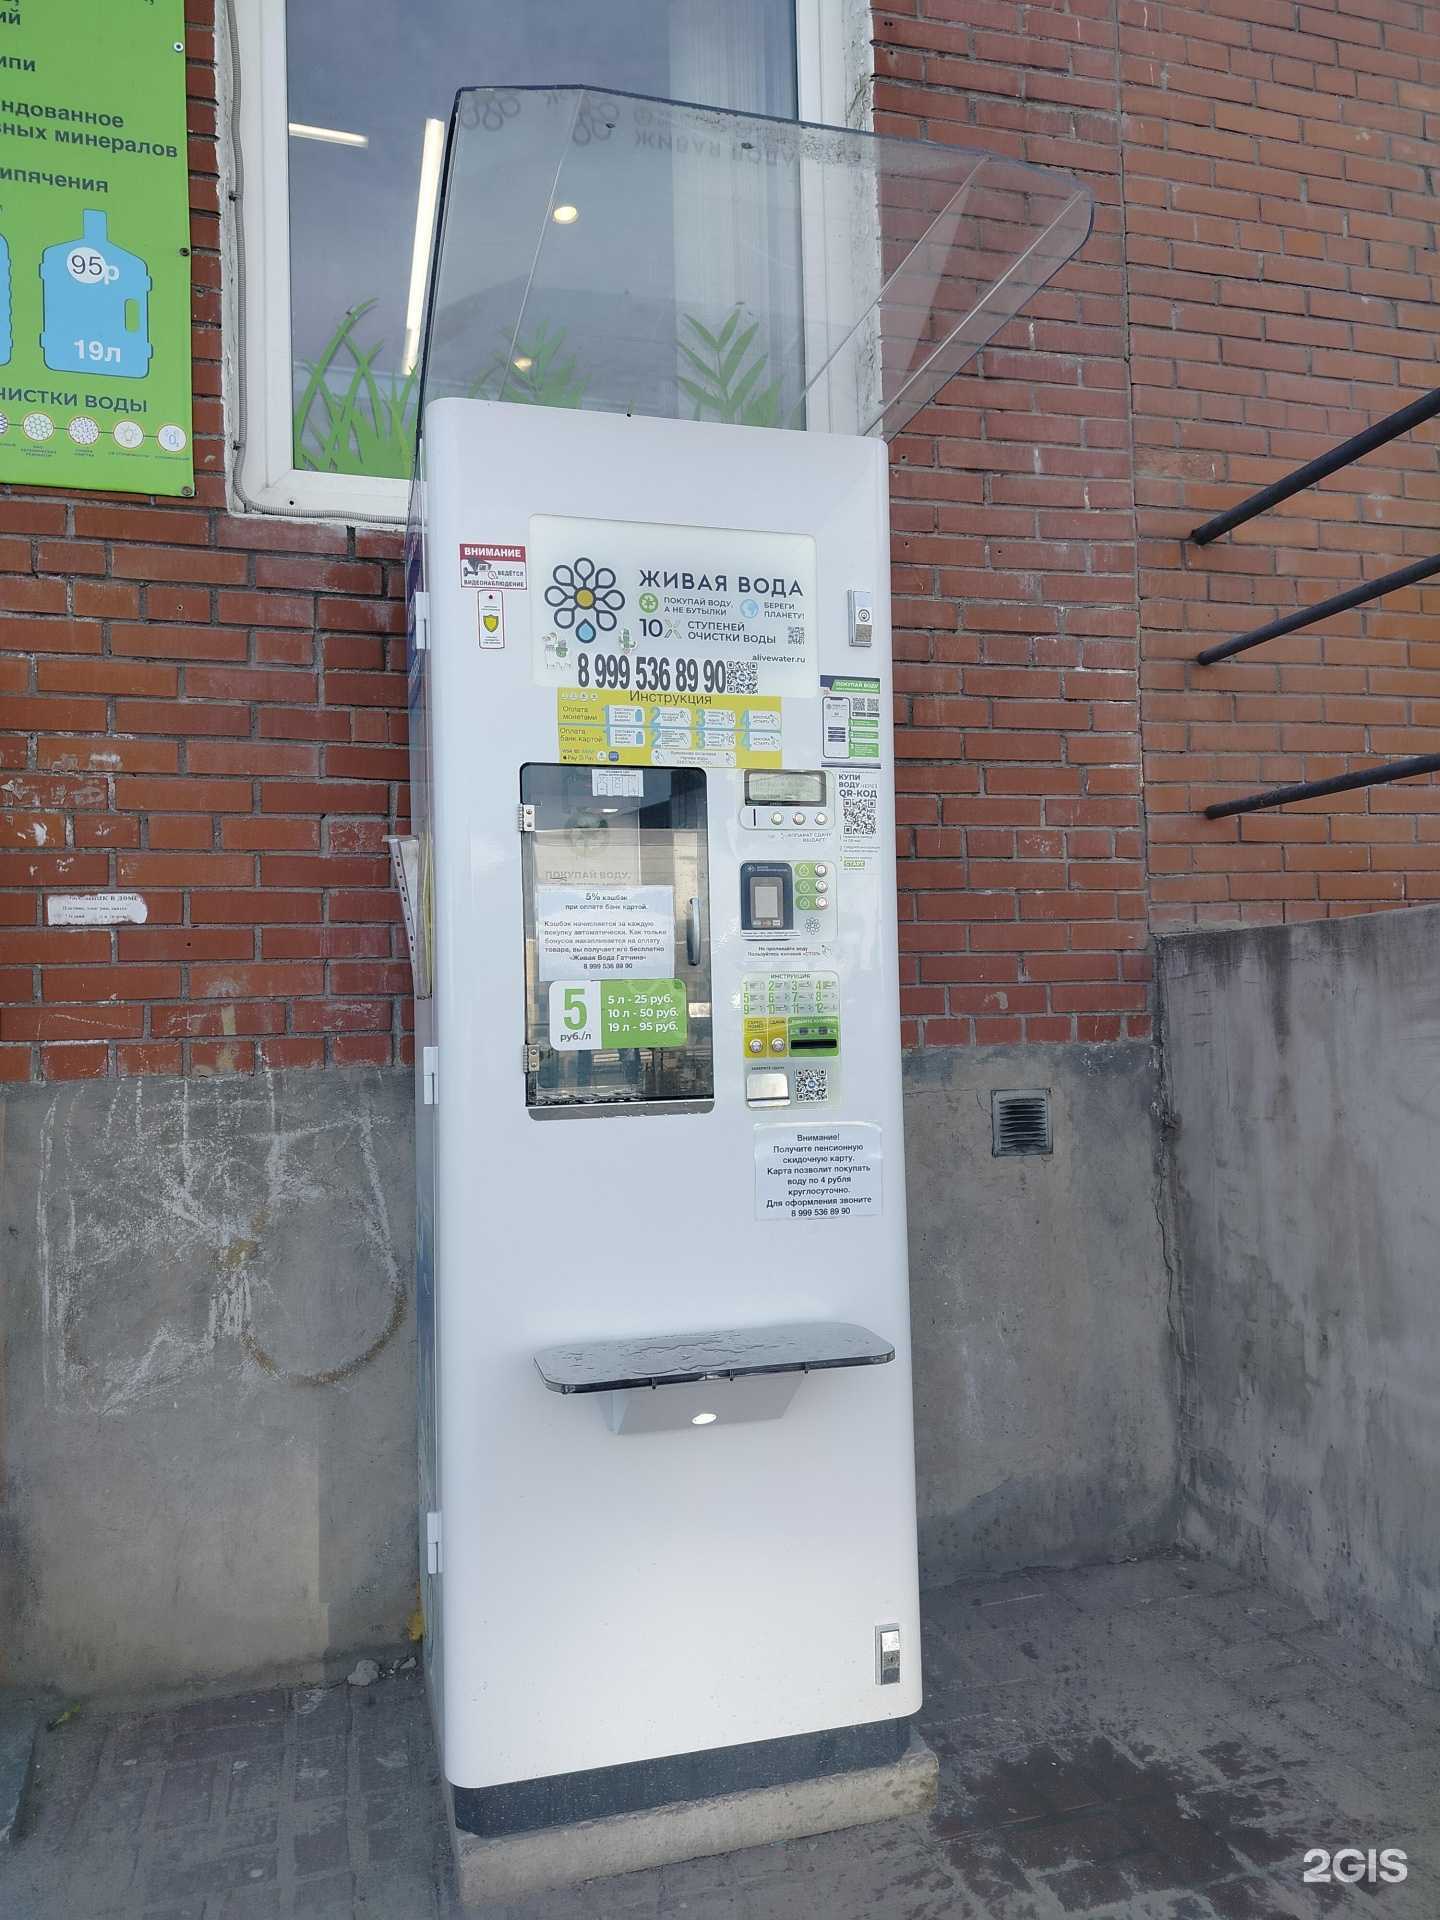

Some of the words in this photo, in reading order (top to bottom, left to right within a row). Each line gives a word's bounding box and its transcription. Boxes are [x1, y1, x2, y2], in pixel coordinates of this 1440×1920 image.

[0, 122, 47, 141] ных
[55, 129, 178, 158] минералов
[74, 339, 121, 363] 19л
[85, 394, 147, 414] ВОДЫ
[464, 547, 522, 558] ВНИМАНИЕ
[463, 579, 525, 588] ВИДЕОНАБЛЮДЕНИЕ
[639, 569, 728, 592] ЖИВАЯ
[738, 577, 804, 598] ВОДА
[664, 596, 706, 606] ПОКУПАЙ
[708, 599, 734, 608] ВОДУ,
[764, 602, 795, 610] БЕРЕГИ
[672, 606, 684, 614] НЕ
[686, 607, 727, 616] БУТЫЛКИ
[764, 611, 805, 620] ПЛАНЕТУ!
[688, 620, 745, 632] СТУПЕНЕЙ
[687, 632, 740, 642] ОЧИСТКИ
[743, 635, 776, 645] ВОДЫ
[752, 654, 806, 663] alivewater.ru
[578, 653, 589, 688] 8
[595, 653, 630, 689] 999
[635, 656, 671, 691] 536
[676, 658, 698, 692] 89
[703, 660, 726, 694] 90
[629, 690, 713, 706] Инструкция
[562, 705, 588, 714] Оплата
[560, 727, 586, 736] Оплата
[838, 781, 860, 789] ВОДУ
[839, 789, 878, 799] QR-КОД
[585, 892, 601, 901] 5%
[623, 903, 648, 911] картой.
[627, 921, 654, 929] каждую
[629, 945, 665, 953] бесплатно
[597, 954, 615, 962] Вода
[608, 995, 615, 1004] 5
[634, 994, 648, 1004] 25
[650, 993, 673, 1006] руб.
[563, 988, 588, 1030] 5
[608, 1009, 620, 1018] 10
[640, 1008, 653, 1017] 50
[656, 1007, 679, 1019] руб.
[608, 1023, 620, 1032] 19
[639, 1022, 653, 1031] 95
[655, 1021, 679, 1033] руб.
[560, 1031, 592, 1043] руб./л
[797, 1133, 840, 1142] Внимание!
[773, 1145, 812, 1154] Получите
[814, 1144, 864, 1153] пенсионную
[783, 1156, 828, 1164] скидочную
[830, 1155, 855, 1163] карту.
[767, 1167, 792, 1176] Карта
[794, 1166, 832, 1174] позволит
[834, 1165, 871, 1173] покупать
[787, 1178, 807, 1186] воду
[827, 1175, 852, 1185] рубля
[788, 1187, 850, 1196] круглосуточно.
[766, 1200, 783, 1208] Для
[785, 1198, 838, 1207] оформления
[798, 1209, 812, 1217] 999
[814, 1208, 828, 1216] 536
[830, 1207, 840, 1215] 89
[841, 1207, 851, 1215] 90
